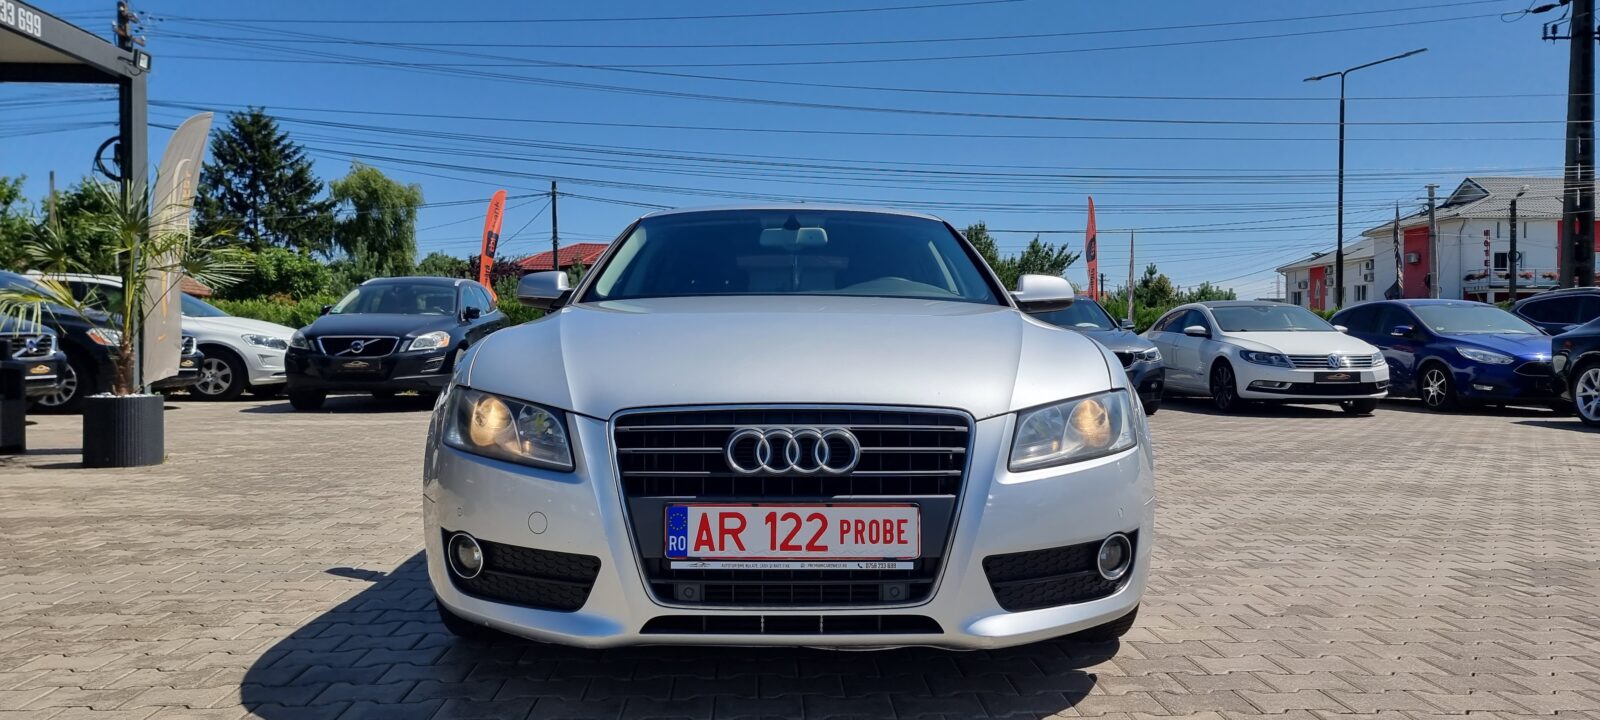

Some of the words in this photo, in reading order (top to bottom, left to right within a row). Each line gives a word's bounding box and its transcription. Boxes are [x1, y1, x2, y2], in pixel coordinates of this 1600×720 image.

[0, 0, 15, 26] 33
[18, 7, 42, 37] 699
[669, 535, 687, 551] RO
[693, 511, 747, 552] AR
[764, 511, 829, 552] 122
[839, 519, 909, 545] PROBE
